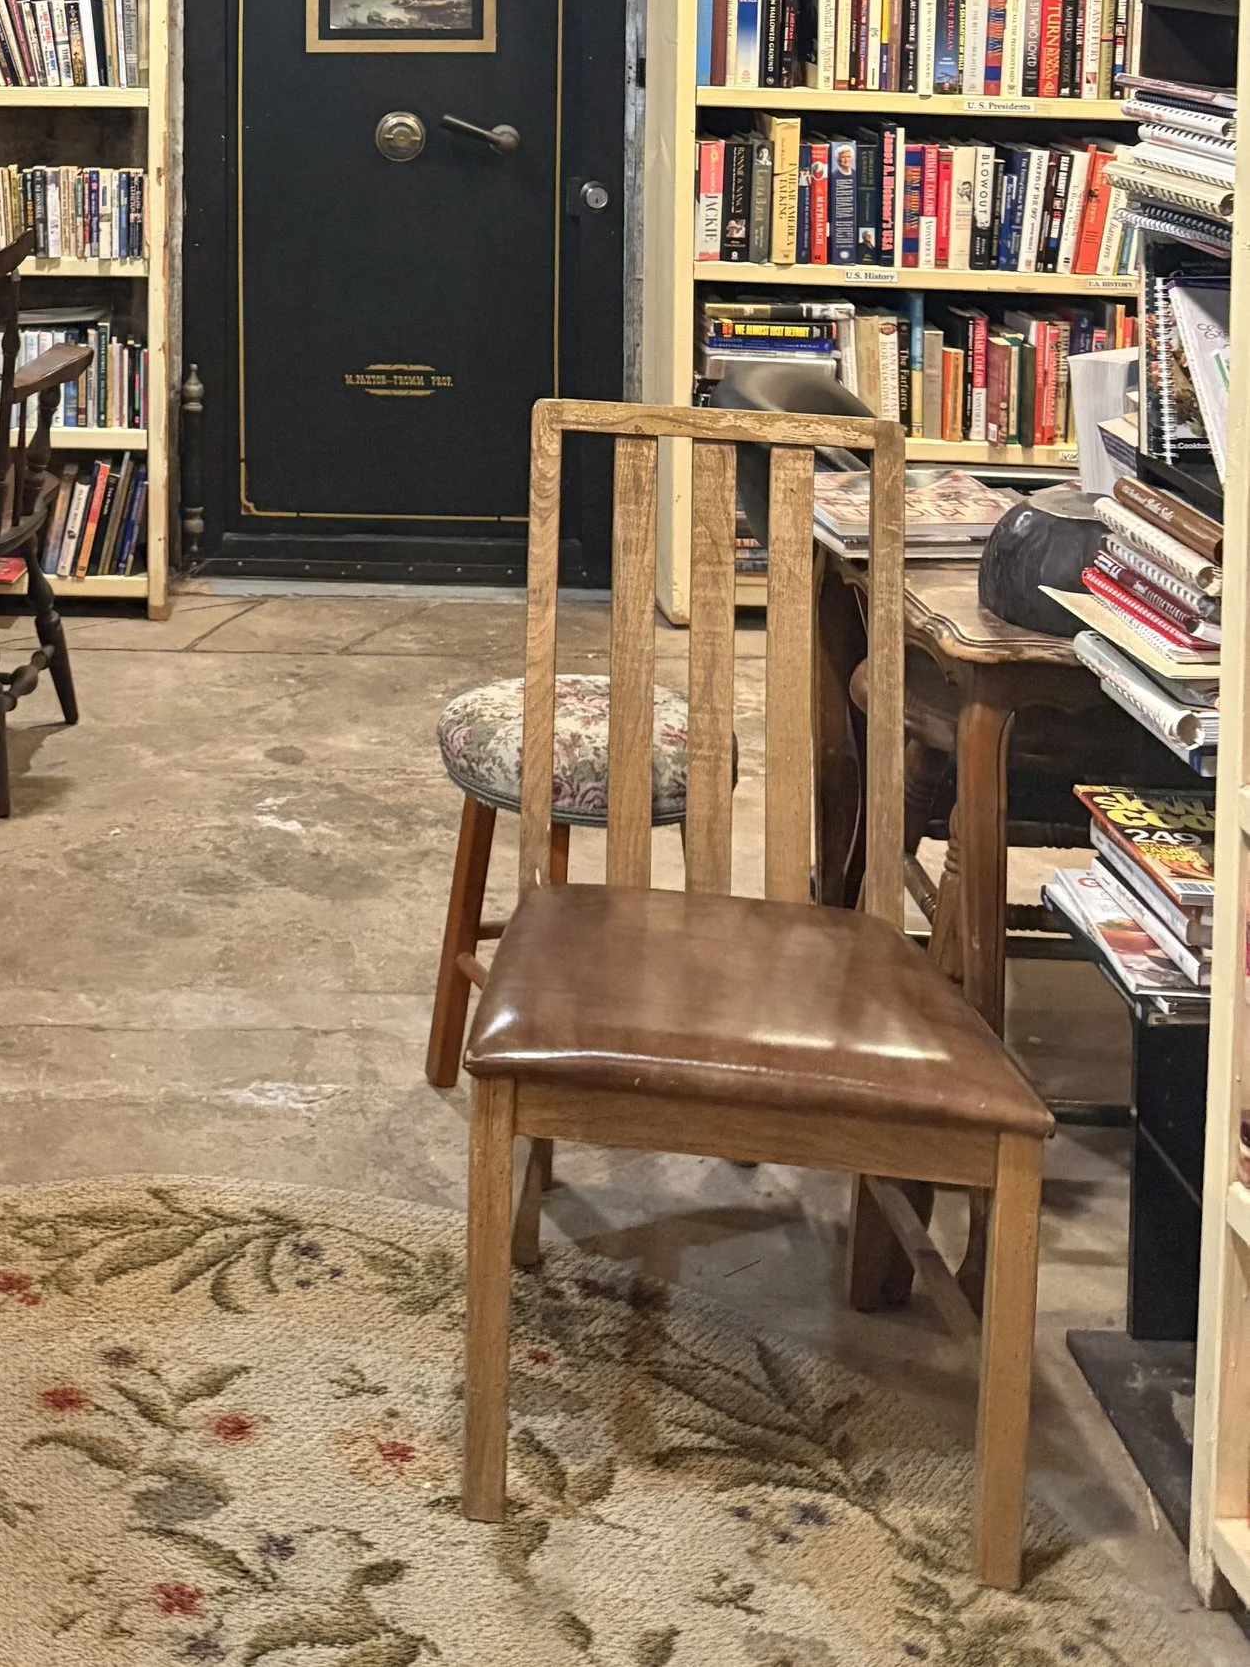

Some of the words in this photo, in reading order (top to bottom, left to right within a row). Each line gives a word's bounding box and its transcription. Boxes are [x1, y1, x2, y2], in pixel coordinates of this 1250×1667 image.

[1030, 2, 1038, 16] SPY
[1092, 8, 1101, 33] AND
[1029, 19, 1038, 38] WHO
[1046, 3, 1061, 46] TURN
[1076, 18, 1084, 45] BUTLER
[767, 42, 775, 72] GROUND
[1028, 41, 1037, 66] LOVED
[1045, 49, 1054, 79] REAGAN
[1090, 36, 1100, 63] FURY
[967, 102, 976, 110] U.
[978, 102, 986, 110] S.
[988, 102, 1032, 112] Presidents
[883, 132, 895, 164] James
[883, 165, 894, 175] A.
[926, 149, 937, 181] PRIMARY
[779, 178, 787, 220] TALKING
[788, 173, 796, 201] HEAR
[979, 154, 990, 214] BLOWOUT
[882, 176, 894, 229] Michener's
[925, 184, 936, 216] COLORS
[705, 195, 718, 243] JACKIE
[787, 204, 795, 246] AMERICA
[816, 196, 824, 245] MATRIARCH
[882, 230, 893, 250] USA
[845, 271, 863, 282] U.S.
[864, 271, 895, 283] History
[1103, 280, 1134, 289] HISTORY
[974, 321, 984, 353] PRIMARY
[900, 348, 910, 366] The
[973, 355, 984, 388] COLORS
[899, 369, 909, 411] Farfarers
[1124, 828, 1202, 846] 249
